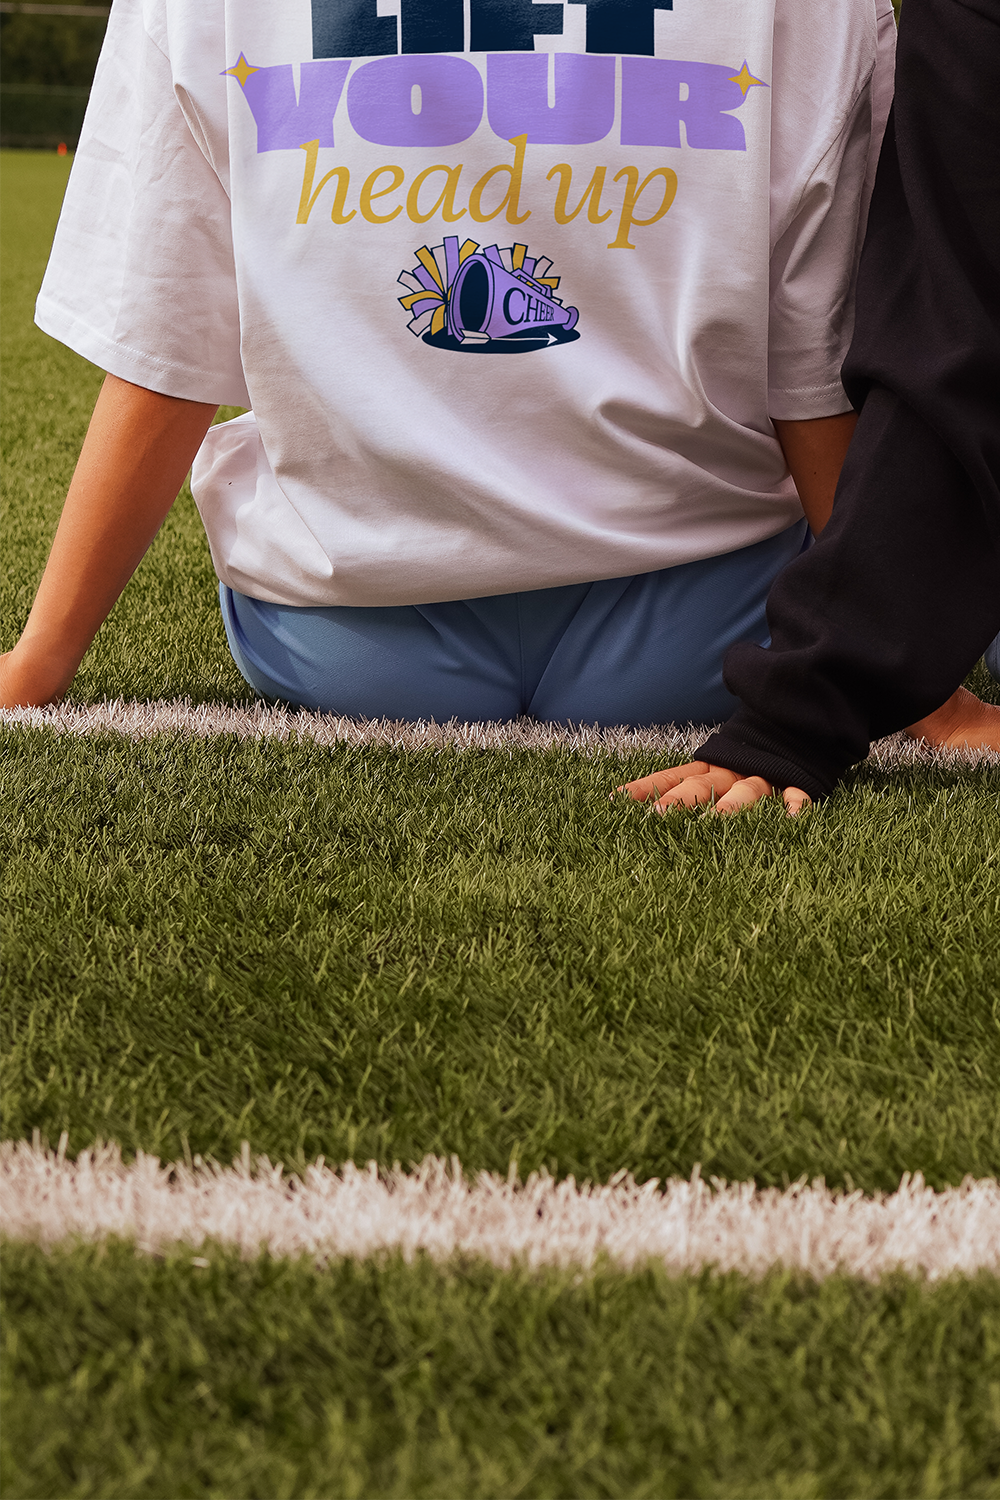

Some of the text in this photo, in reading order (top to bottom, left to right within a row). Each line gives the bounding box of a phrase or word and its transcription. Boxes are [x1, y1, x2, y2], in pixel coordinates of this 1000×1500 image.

[241, 52, 748, 153] YOUR
[295, 134, 679, 250] head up
